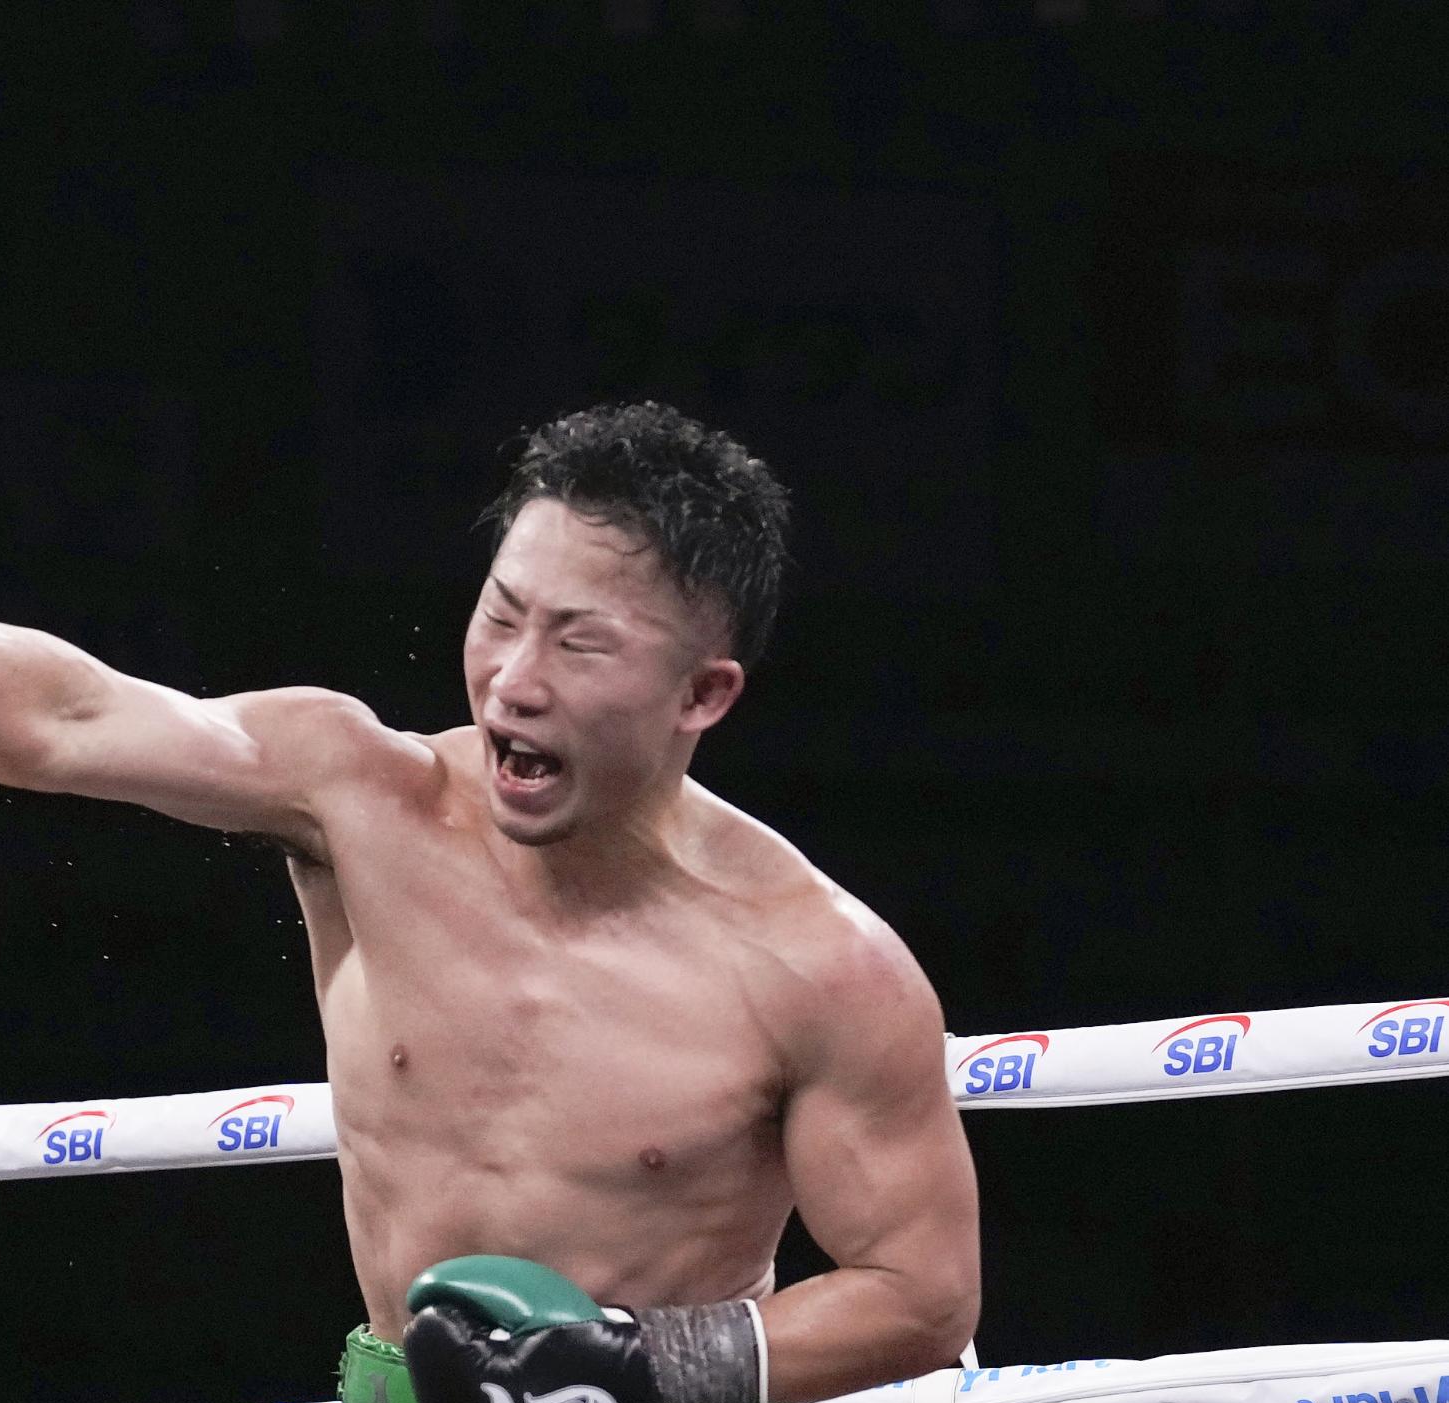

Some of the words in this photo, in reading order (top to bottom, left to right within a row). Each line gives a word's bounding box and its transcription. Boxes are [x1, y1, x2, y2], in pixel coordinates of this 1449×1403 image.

[1164, 1035, 1237, 1076] SBI
[1368, 1016, 1445, 1058] SBI
[965, 1054, 1036, 1094] SBI
[43, 1128, 104, 1165] SBI
[217, 1115, 281, 1151] SBI
